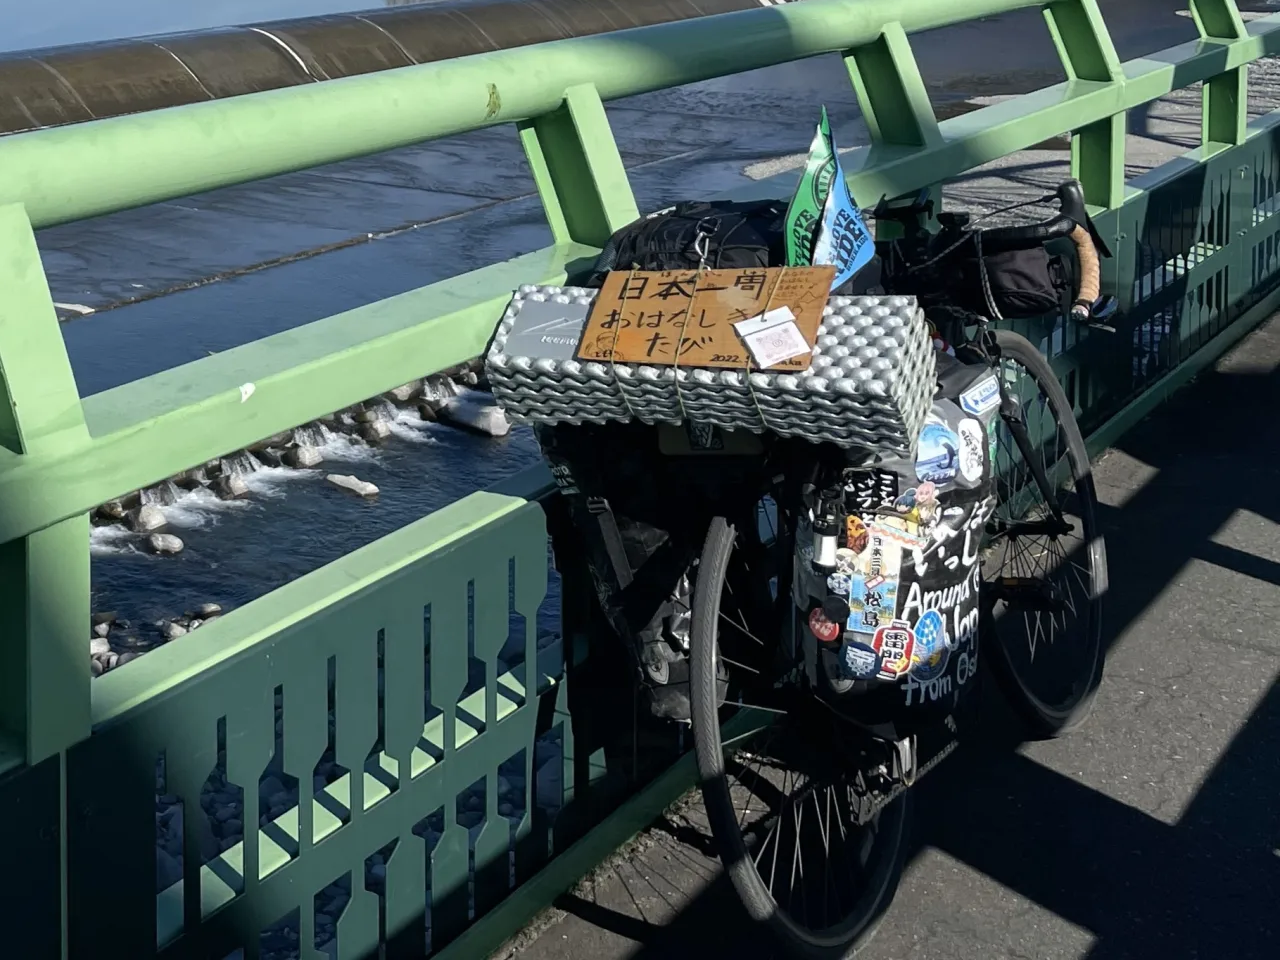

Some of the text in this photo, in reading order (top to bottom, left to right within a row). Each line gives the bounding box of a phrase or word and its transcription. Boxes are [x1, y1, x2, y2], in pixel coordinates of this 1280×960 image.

[618, 275, 767, 300] 日本一周
[644, 332, 714, 357] たび
[862, 591, 883, 628] 松島
